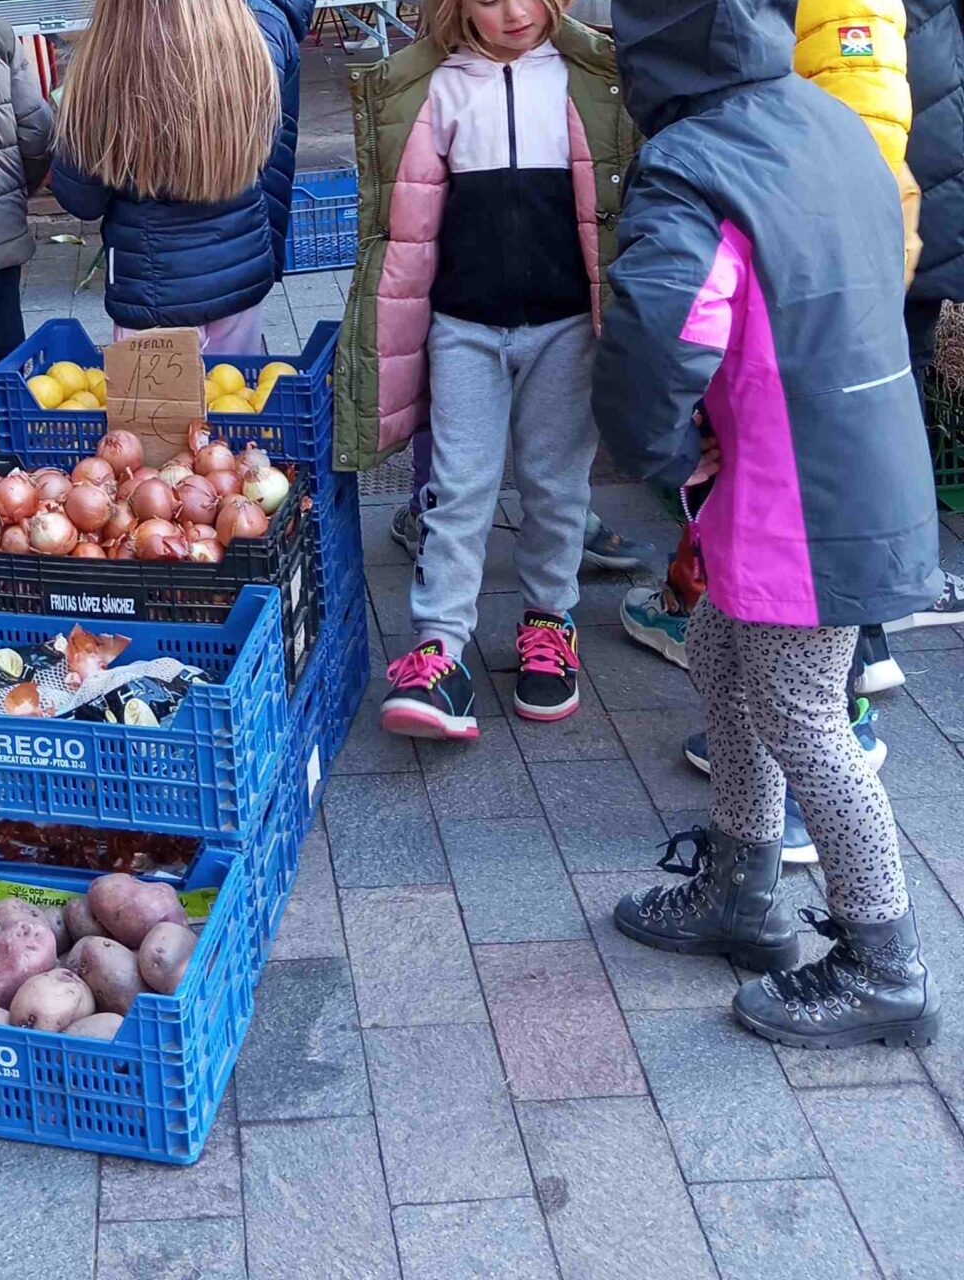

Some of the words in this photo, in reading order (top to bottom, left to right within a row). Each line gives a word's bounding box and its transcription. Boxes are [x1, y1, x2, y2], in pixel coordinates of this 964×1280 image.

[130, 339, 174, 352] OFERTA
[50, 593, 77, 611] FRUTAS
[78, 592, 101, 613] LÓPEZ
[102, 593, 136, 615] SÁNCHEZ
[20, 756, 32, 766] DEL
[32, 757, 49, 766] CAMP
[29, 895, 70, 908] NATURA
